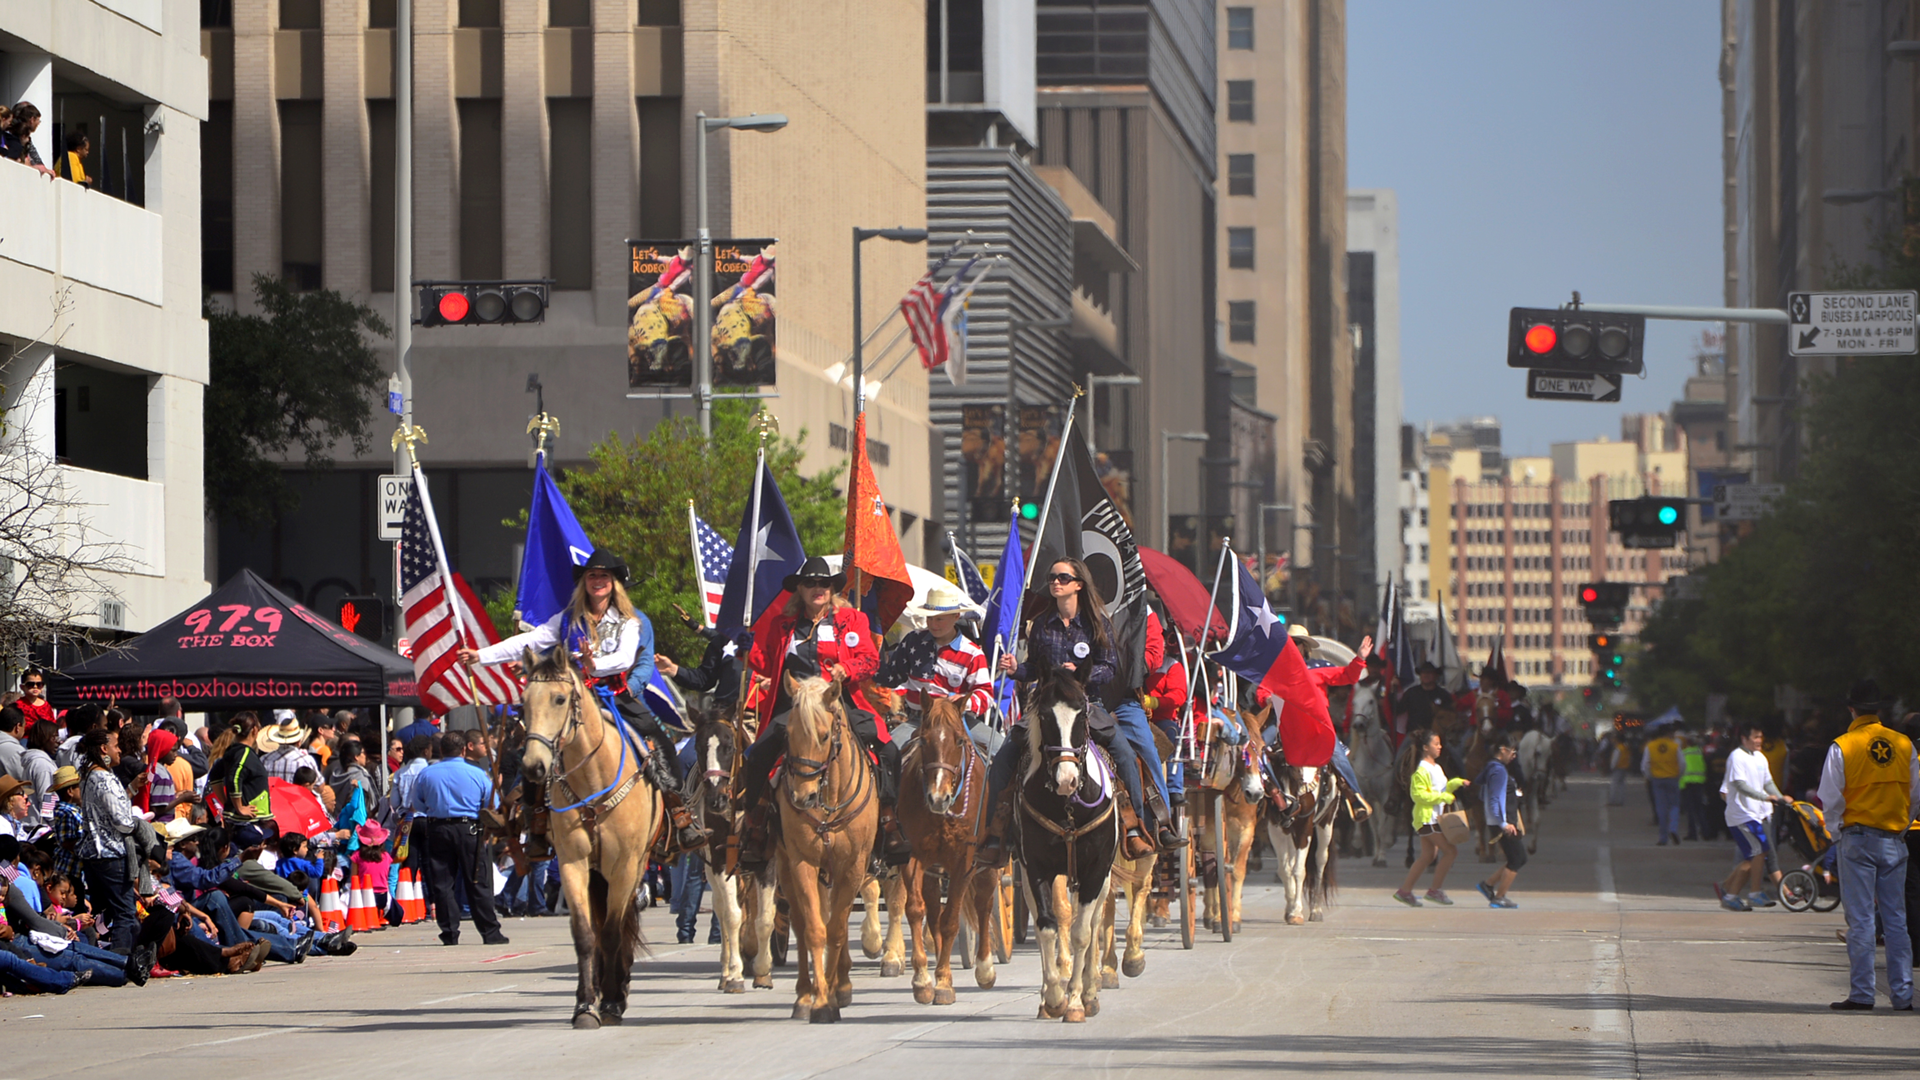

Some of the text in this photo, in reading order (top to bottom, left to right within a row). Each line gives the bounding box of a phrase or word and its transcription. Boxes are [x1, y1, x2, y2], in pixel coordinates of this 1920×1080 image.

[1823, 295, 1910, 309] SECOND LANE
[1821, 311, 1852, 323] BUSES
[1862, 310, 1913, 322] CARPOOLS
[1823, 327, 1913, 338] 7-9AM & 4-6PM
[1837, 340, 1866, 349] MON
[1879, 339, 1899, 349] FRI
[1538, 379, 1595, 394] ONE WAY
[386, 481, 409, 496] ON
[385, 499, 407, 514] WA
[1081, 498, 1147, 614] POW MIA
[184, 604, 283, 634] 97.9
[178, 634, 277, 648] THE BOX
[76, 677, 358, 699] www.theboxhouston.com
